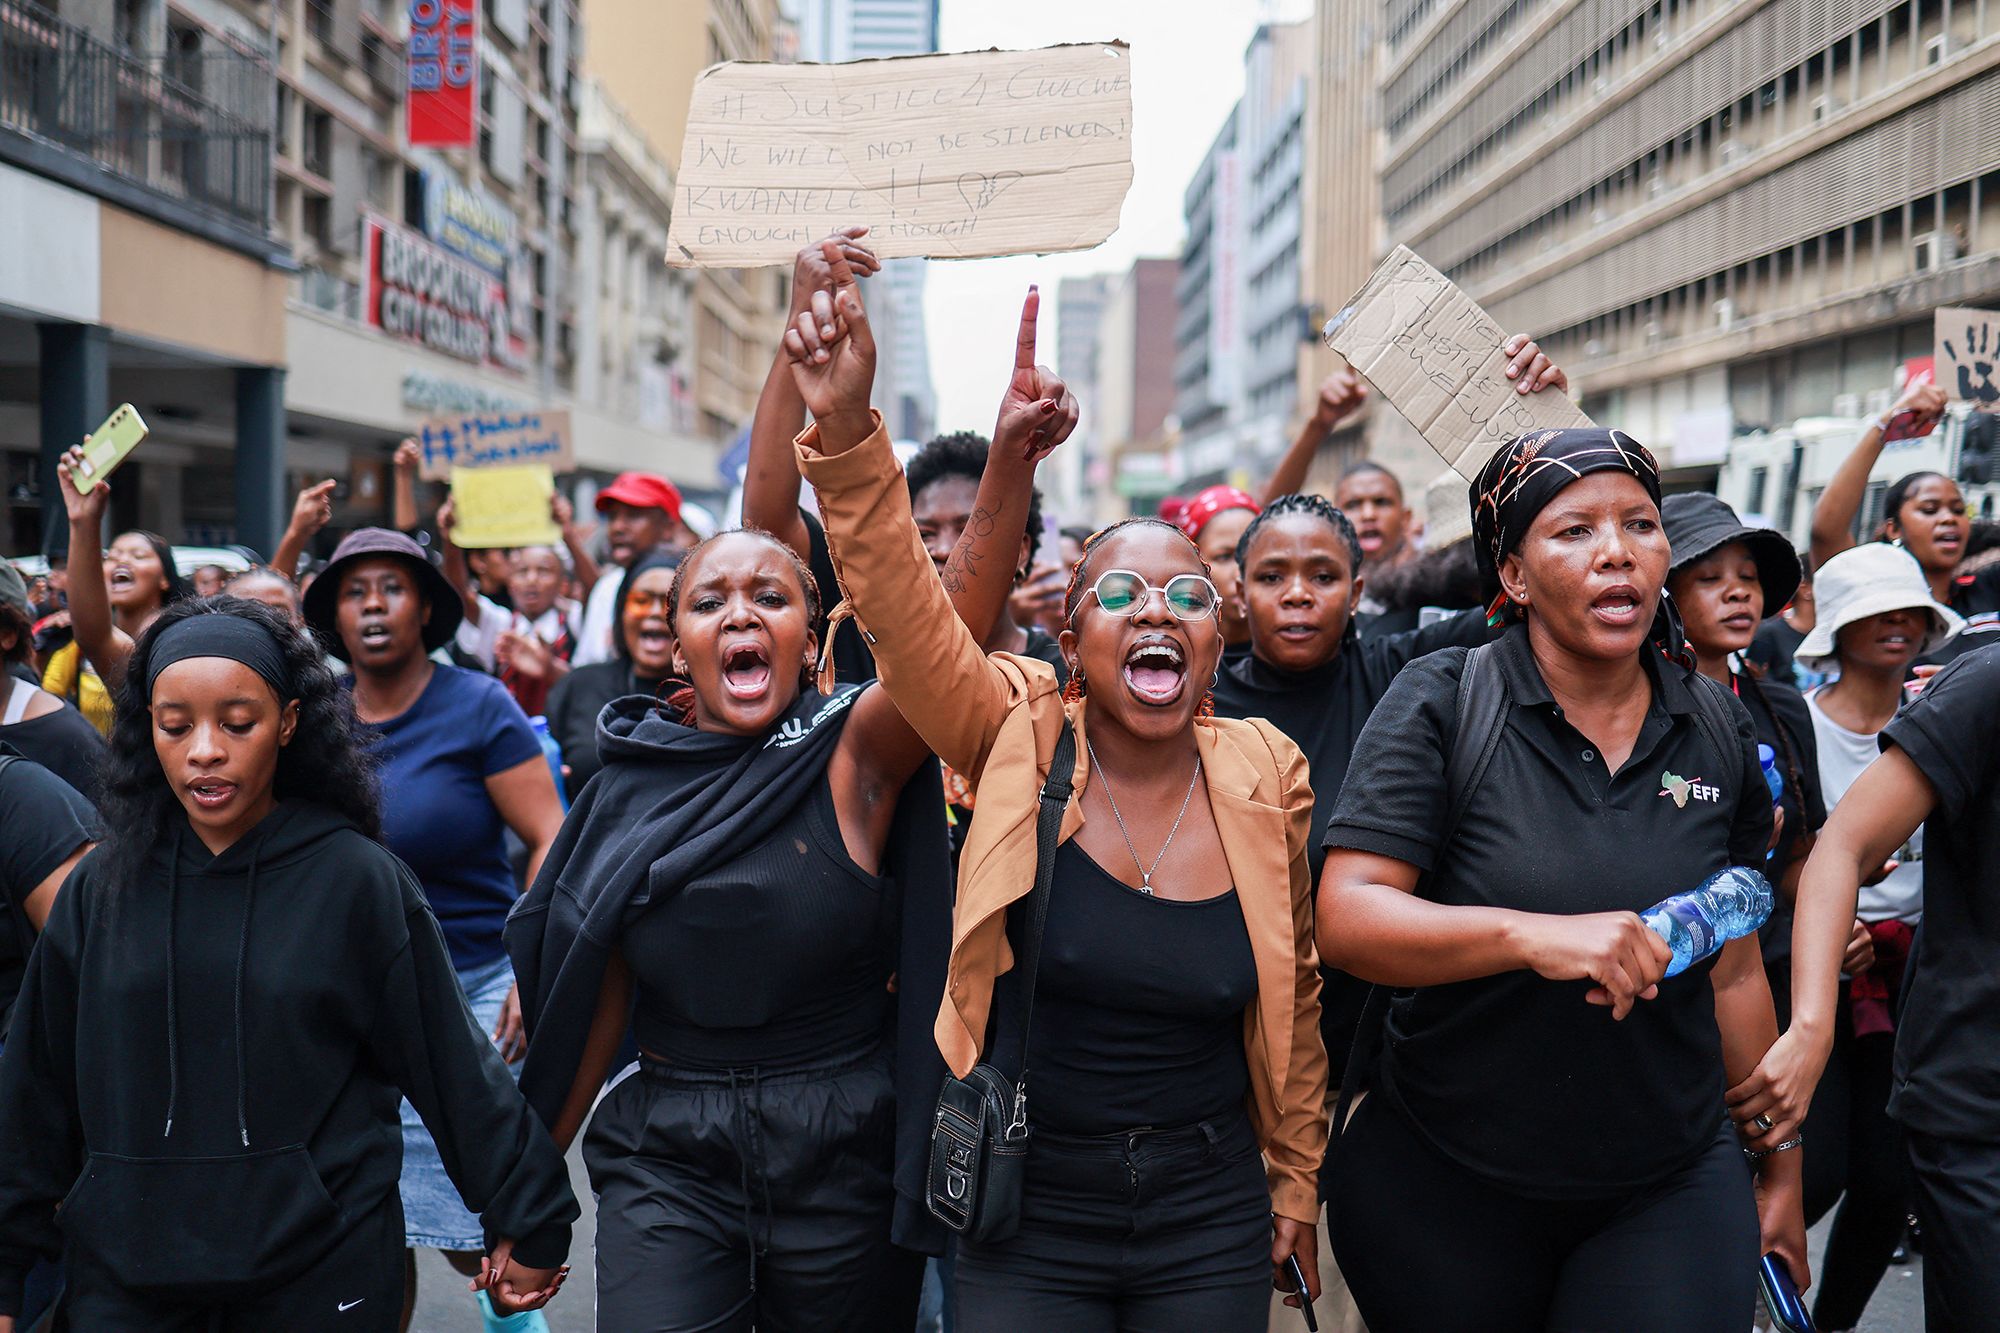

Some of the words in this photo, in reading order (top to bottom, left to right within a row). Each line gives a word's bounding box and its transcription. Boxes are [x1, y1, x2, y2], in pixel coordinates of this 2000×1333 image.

[445, 3, 473, 86] CITY
[768, 147, 848, 167] WILL
[867, 139, 914, 161] NOT
[937, 132, 972, 152] BE
[982, 117, 1125, 148] SILENCED!
[699, 224, 811, 246] ENOUGH
[1404, 295, 1501, 398] JUSTICE
[1498, 397, 1541, 430] FO
[1692, 783, 1720, 802] EFF
